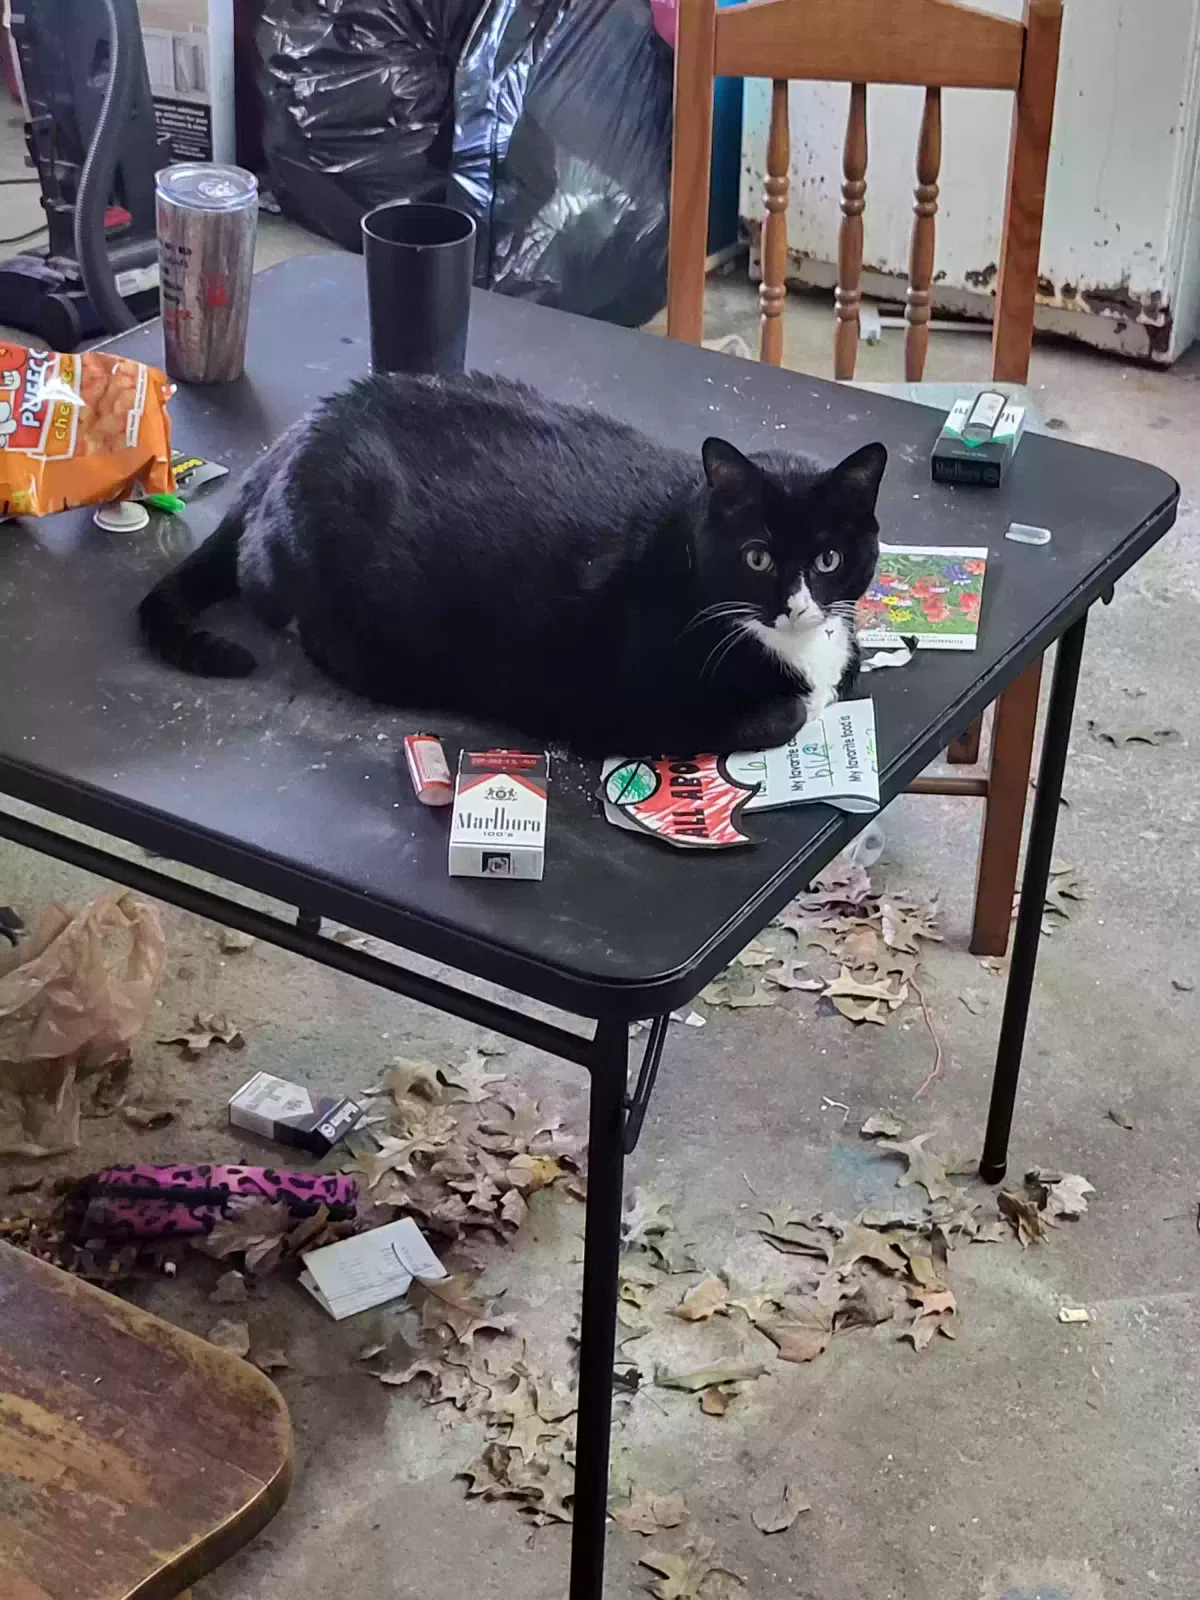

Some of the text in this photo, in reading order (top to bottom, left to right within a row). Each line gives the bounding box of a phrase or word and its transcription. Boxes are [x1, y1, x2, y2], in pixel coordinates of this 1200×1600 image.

[55, 371, 73, 439] chee
[839, 721, 854, 737] food
[786, 748, 802, 779] favorite
[842, 738, 859, 769] favorite
[790, 780, 806, 792] My
[848, 771, 864, 782] My
[667, 757, 709, 838] ALL ABO
[456, 806, 541, 832] Marlboro
